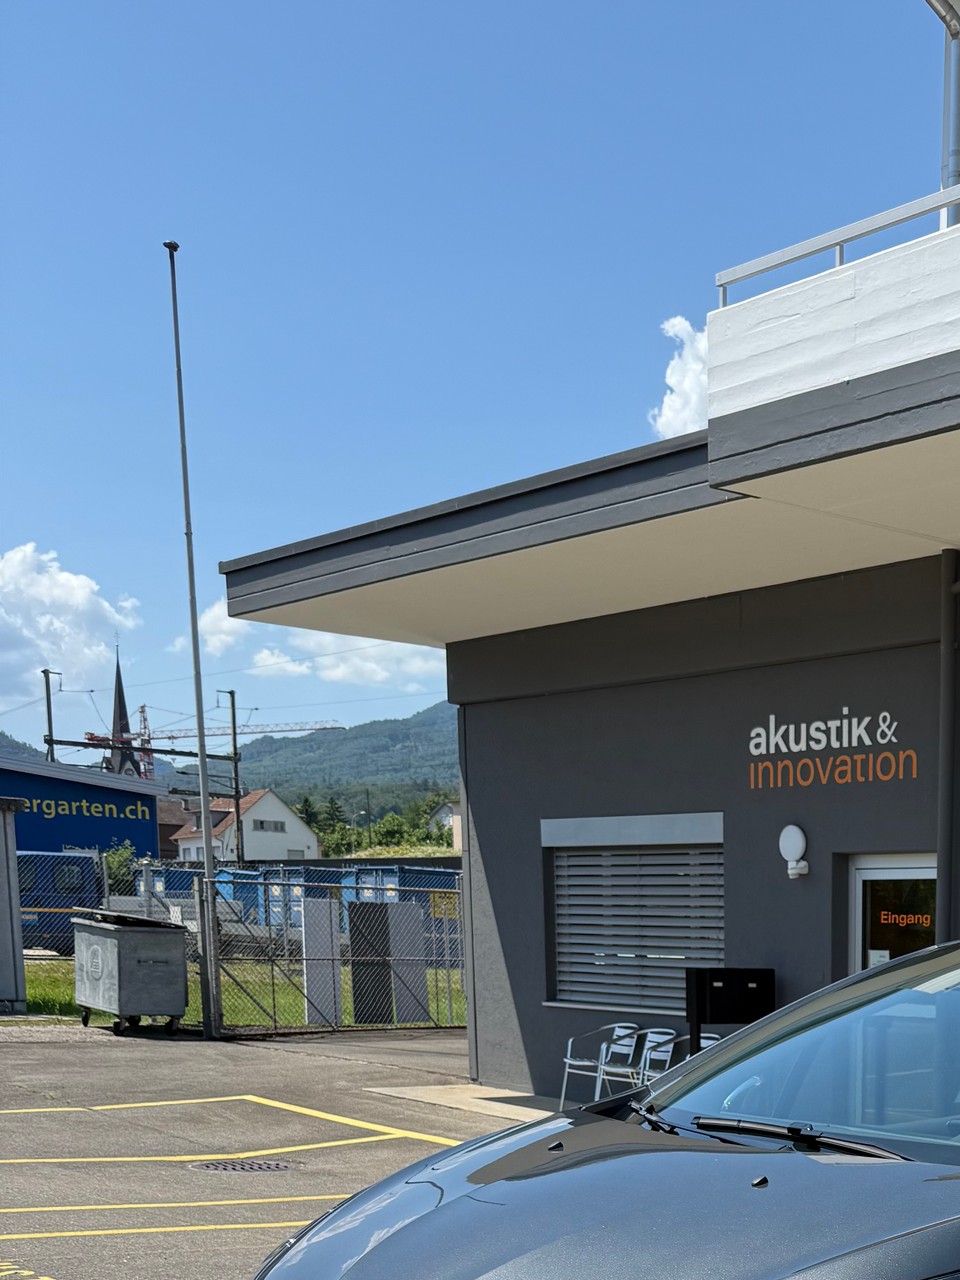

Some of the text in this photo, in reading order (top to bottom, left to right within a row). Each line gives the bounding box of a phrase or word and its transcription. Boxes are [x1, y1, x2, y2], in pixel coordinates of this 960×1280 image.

[750, 707, 898, 756] akustik &
[750, 749, 918, 789] innovation
[880, 911, 931, 927] Eingang
